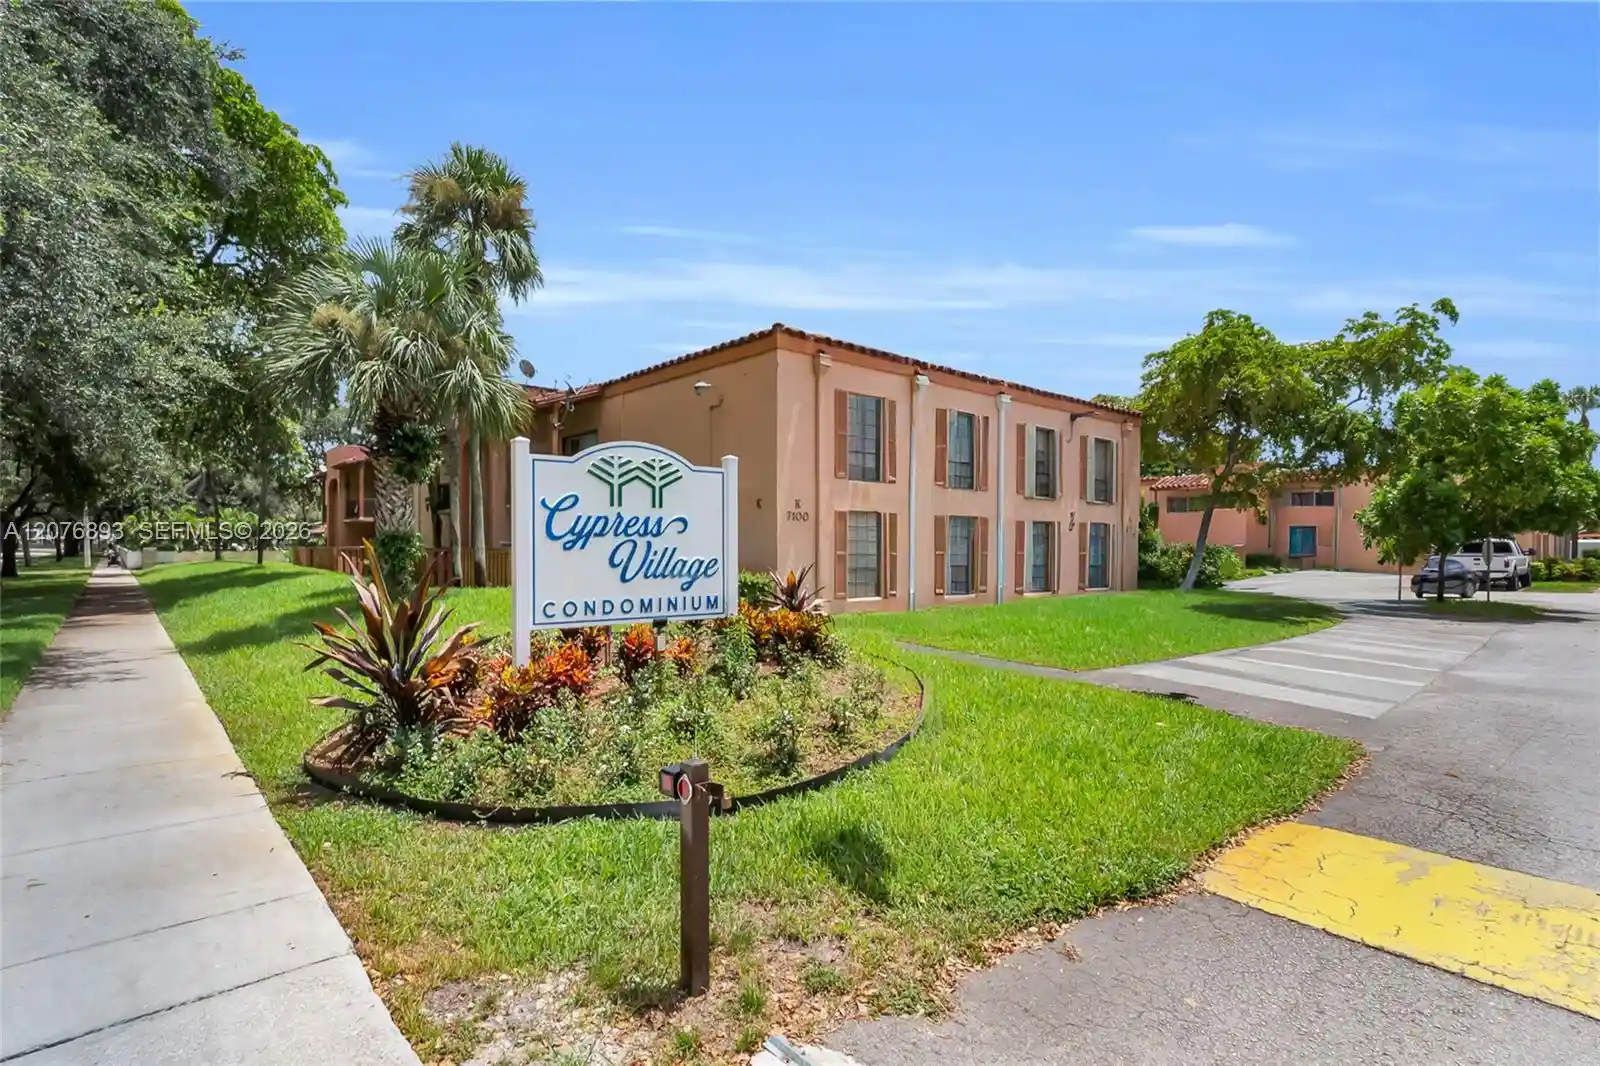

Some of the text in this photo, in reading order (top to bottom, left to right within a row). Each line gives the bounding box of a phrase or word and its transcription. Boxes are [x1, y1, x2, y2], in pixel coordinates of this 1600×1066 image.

[540, 493, 688, 551] Cypress
[786, 511, 809, 522] 7100
[608, 539, 719, 592] Village
[543, 595, 719, 619] CONDOMINIUM
